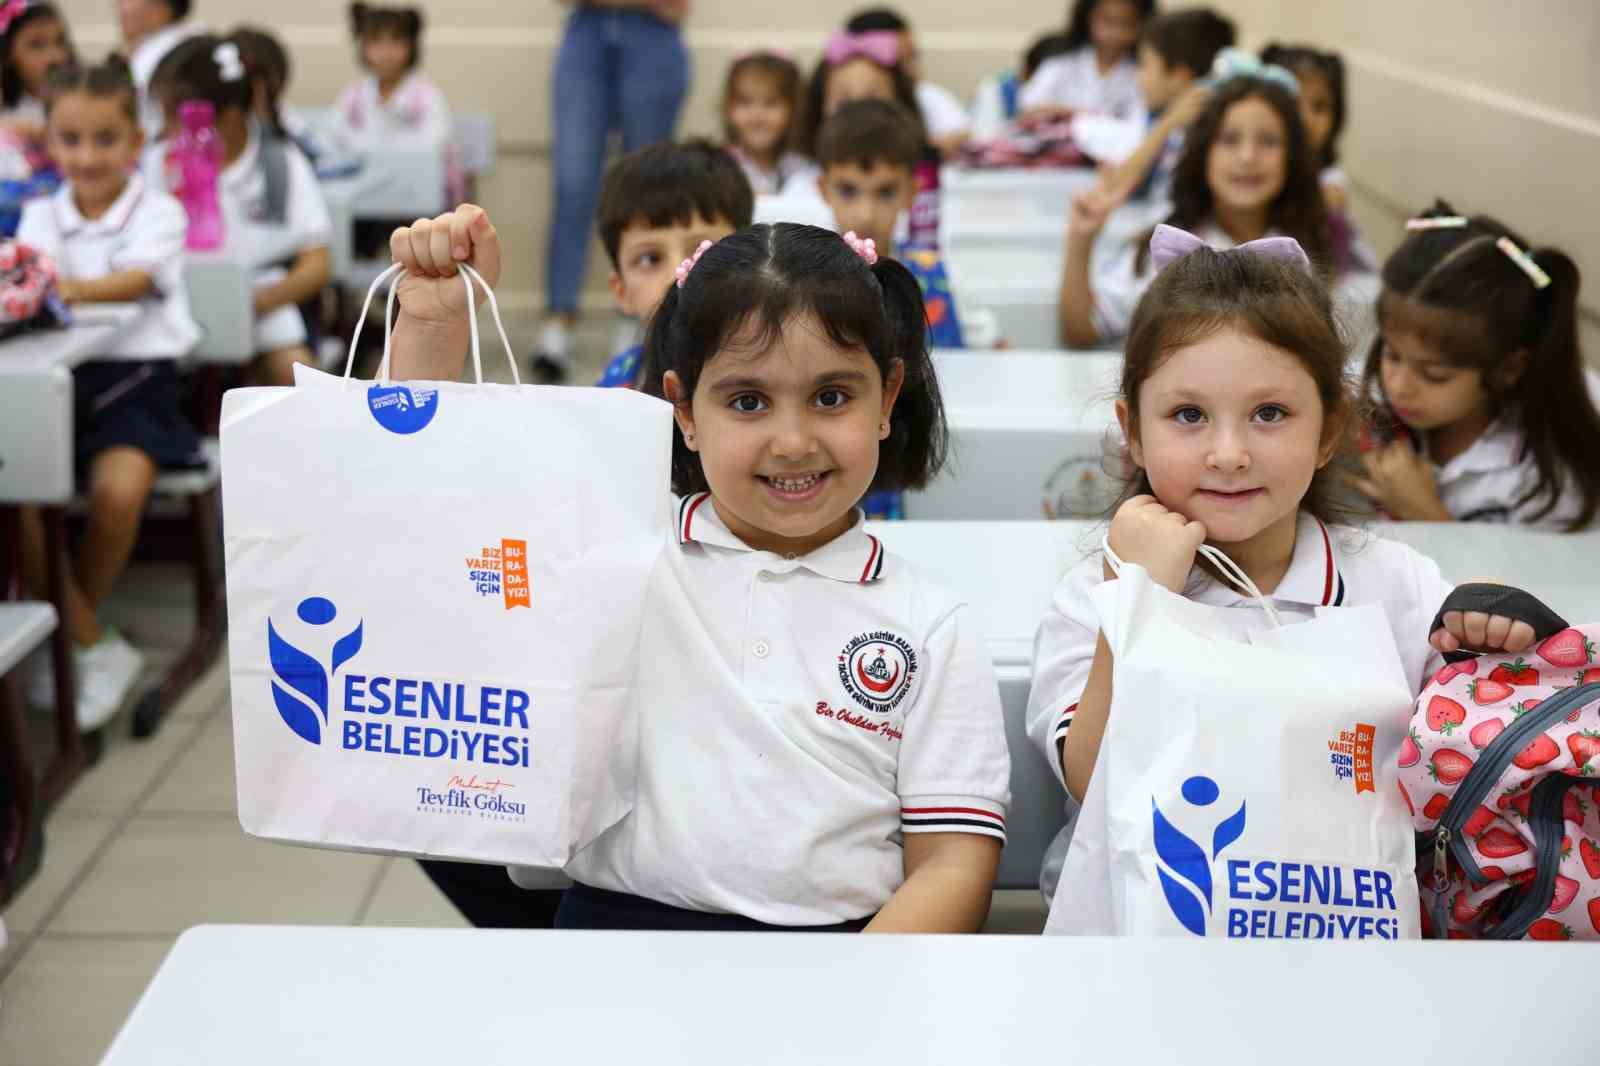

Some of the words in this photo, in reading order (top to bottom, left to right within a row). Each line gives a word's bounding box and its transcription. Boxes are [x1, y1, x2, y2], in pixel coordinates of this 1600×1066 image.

[344, 674, 530, 729] ESENLER
[416, 786, 471, 809] Tevfik
[474, 793, 527, 815] Göksu
[1227, 859, 1397, 911] ESENLER
